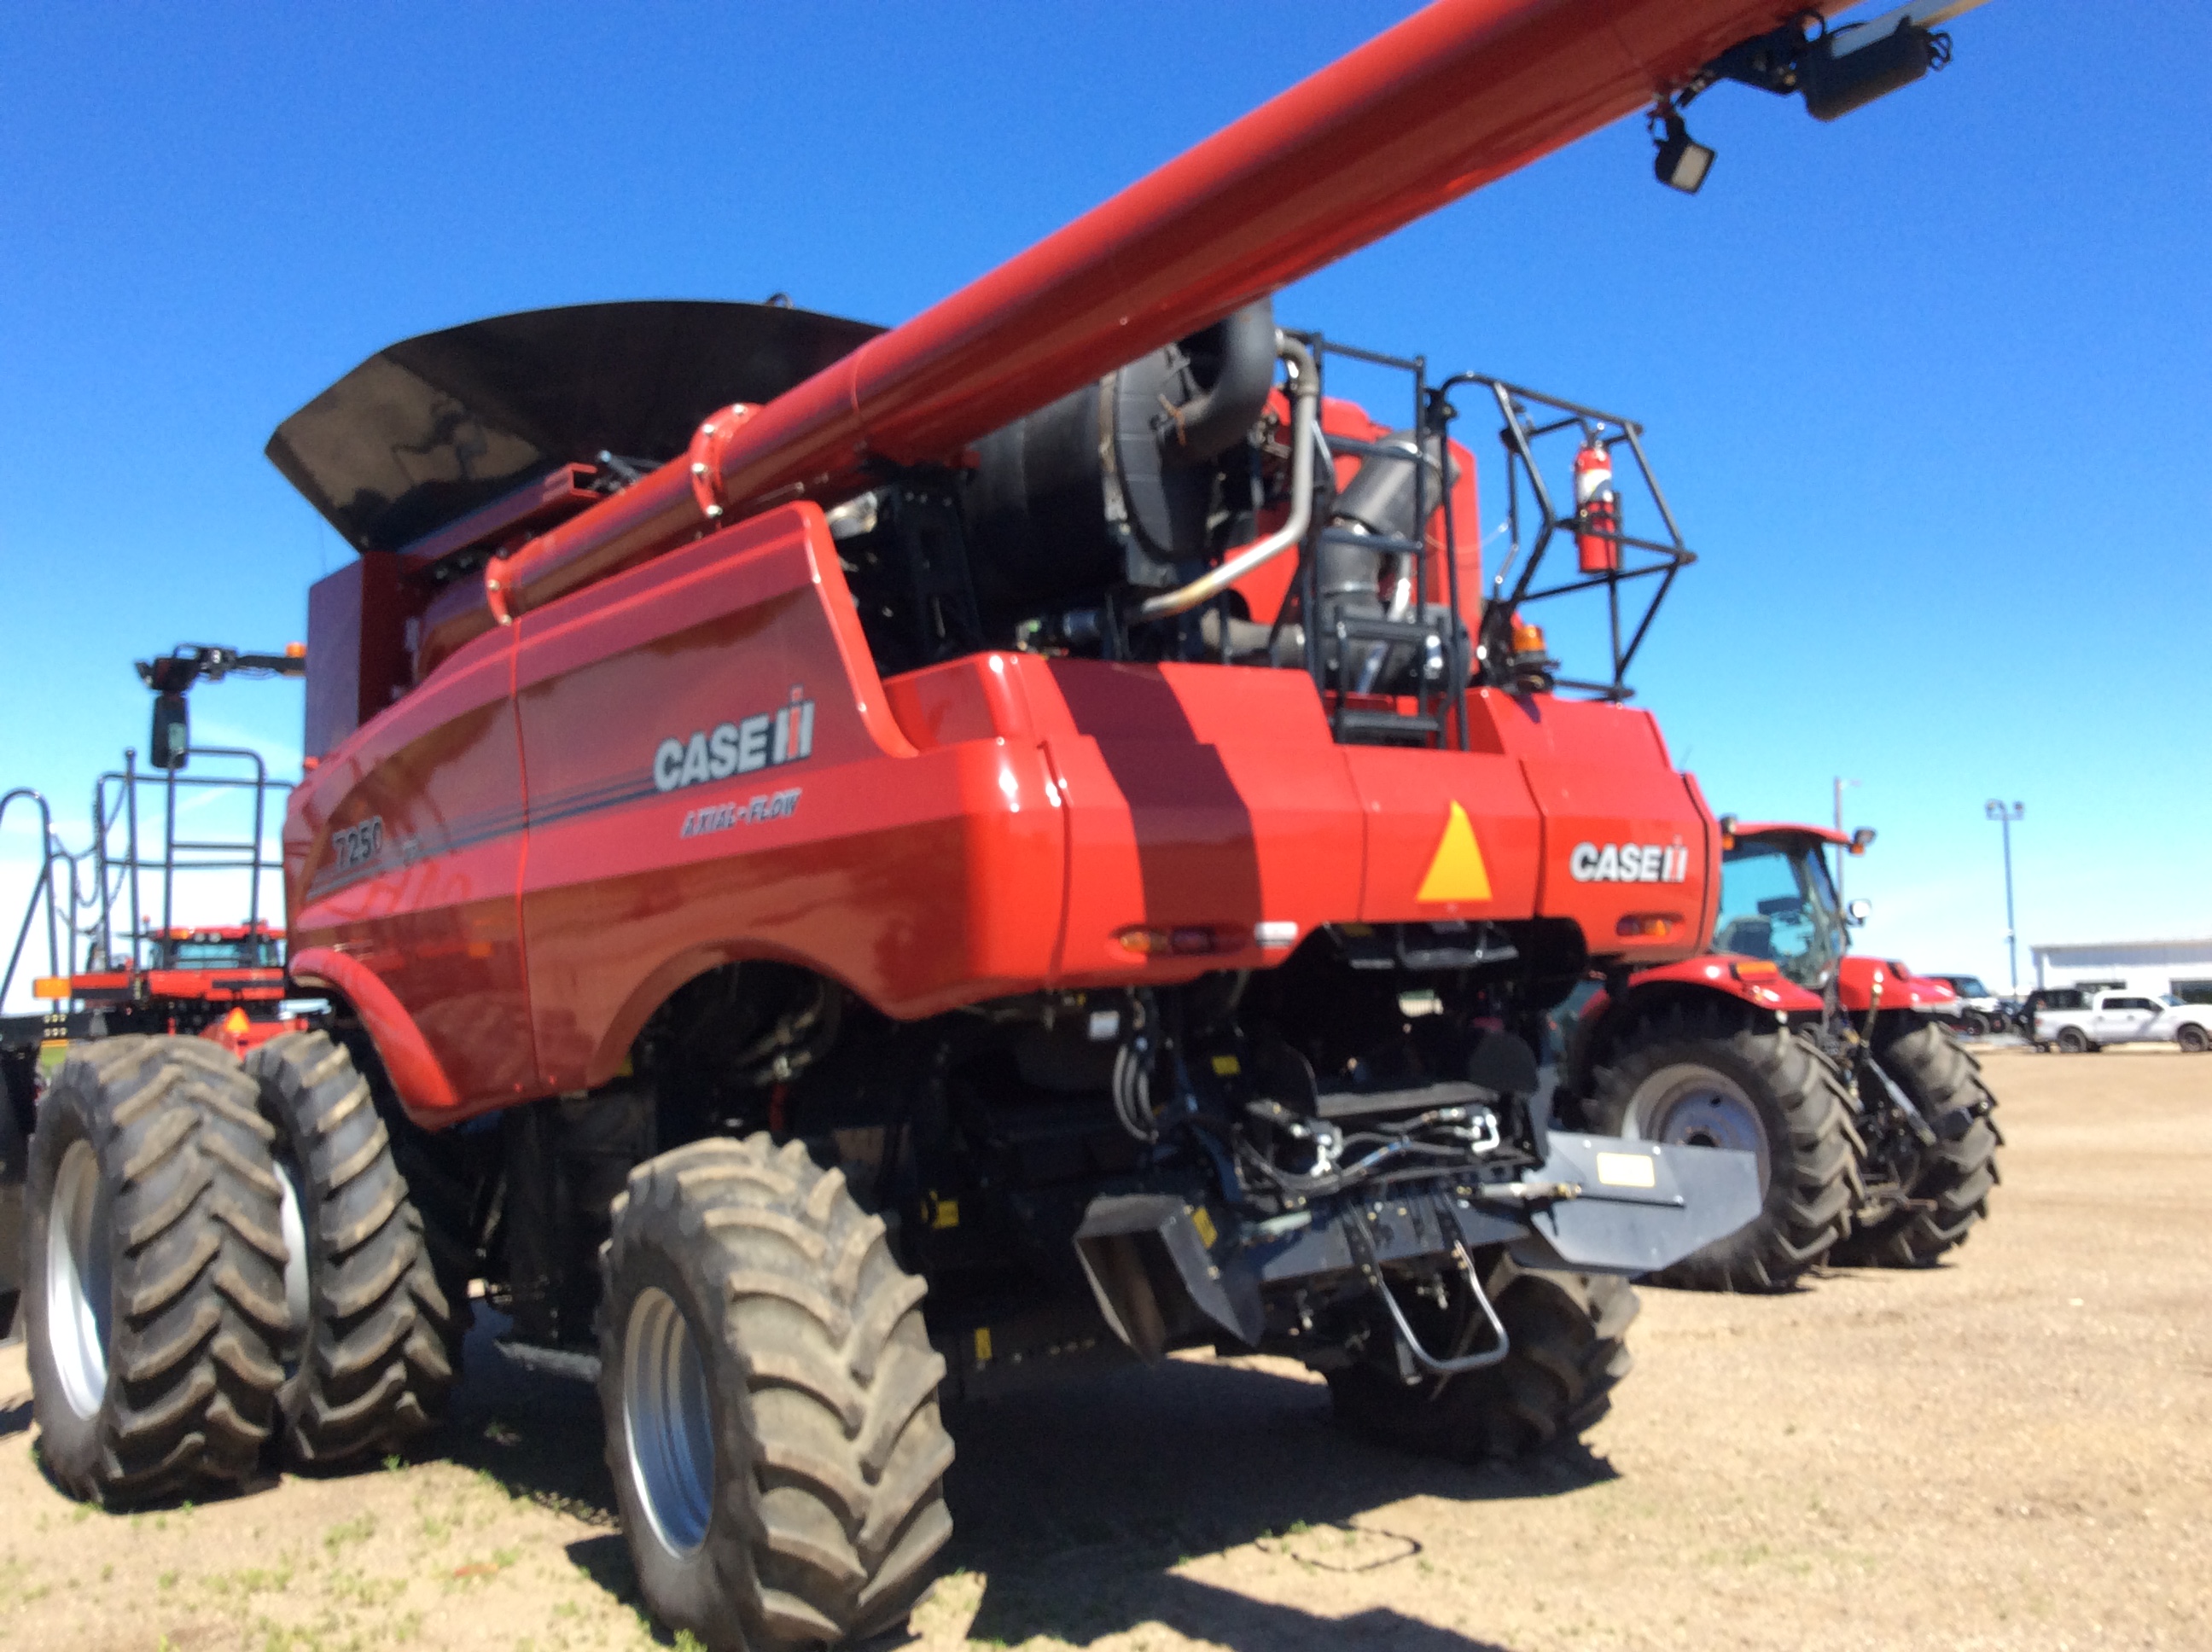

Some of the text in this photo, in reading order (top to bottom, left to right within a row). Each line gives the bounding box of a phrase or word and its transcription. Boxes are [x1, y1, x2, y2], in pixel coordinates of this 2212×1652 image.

[654, 711, 769, 792] CASE
[680, 788, 802, 840] AXIAL-FLOW
[332, 815, 383, 870] 7250
[1569, 841, 1662, 883] CASE
